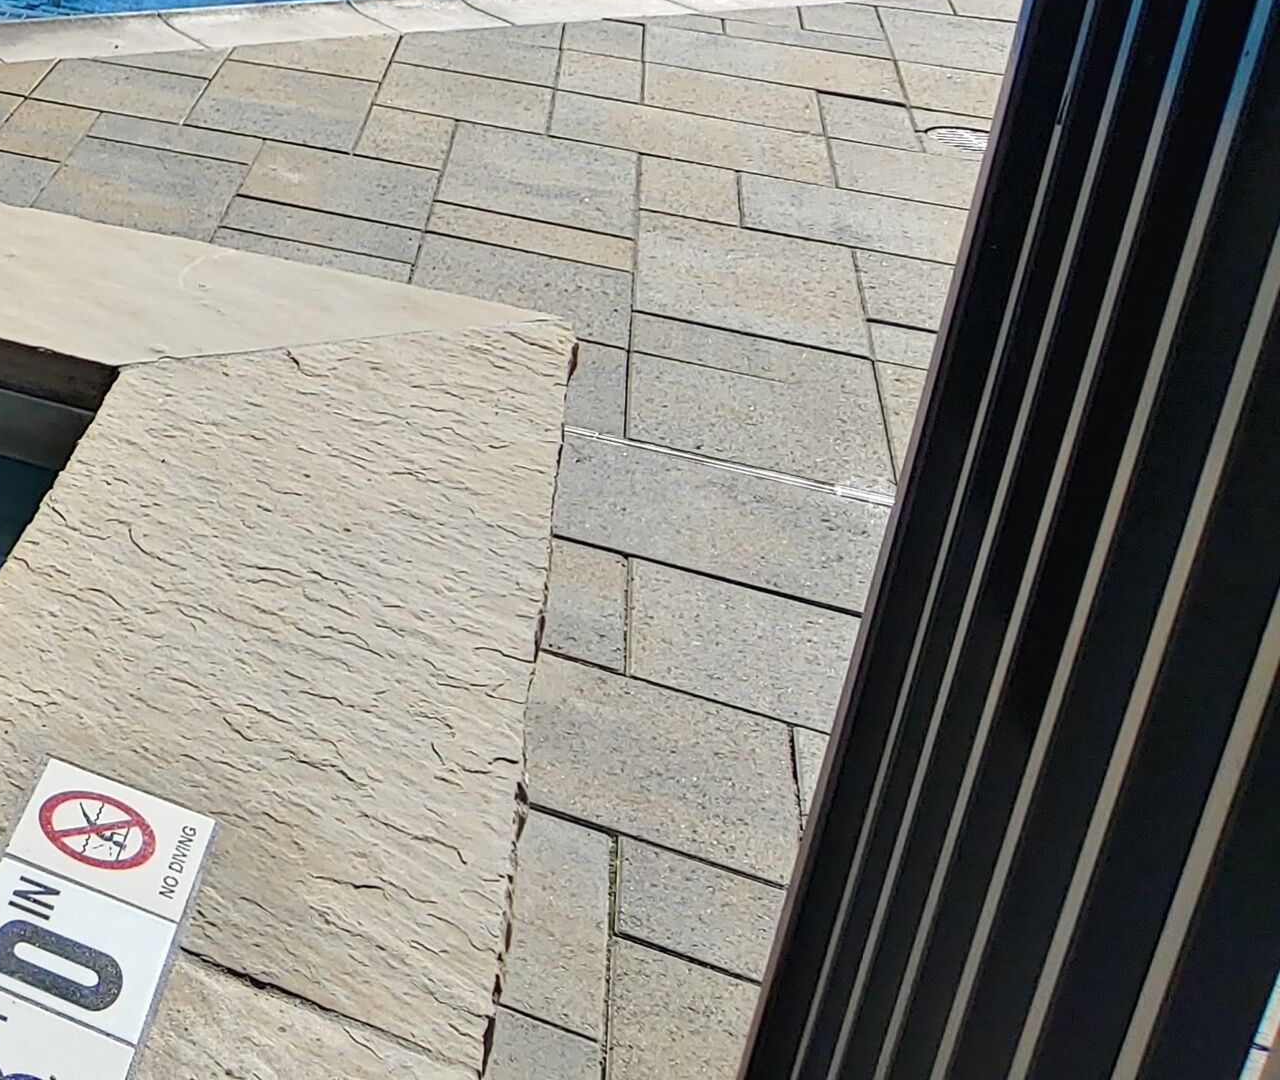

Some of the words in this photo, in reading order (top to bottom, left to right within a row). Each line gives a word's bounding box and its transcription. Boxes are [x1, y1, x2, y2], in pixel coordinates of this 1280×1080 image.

[168, 825, 197, 874] DIVING
[8, 875, 61, 921] IN
[158, 875, 179, 900] NO
